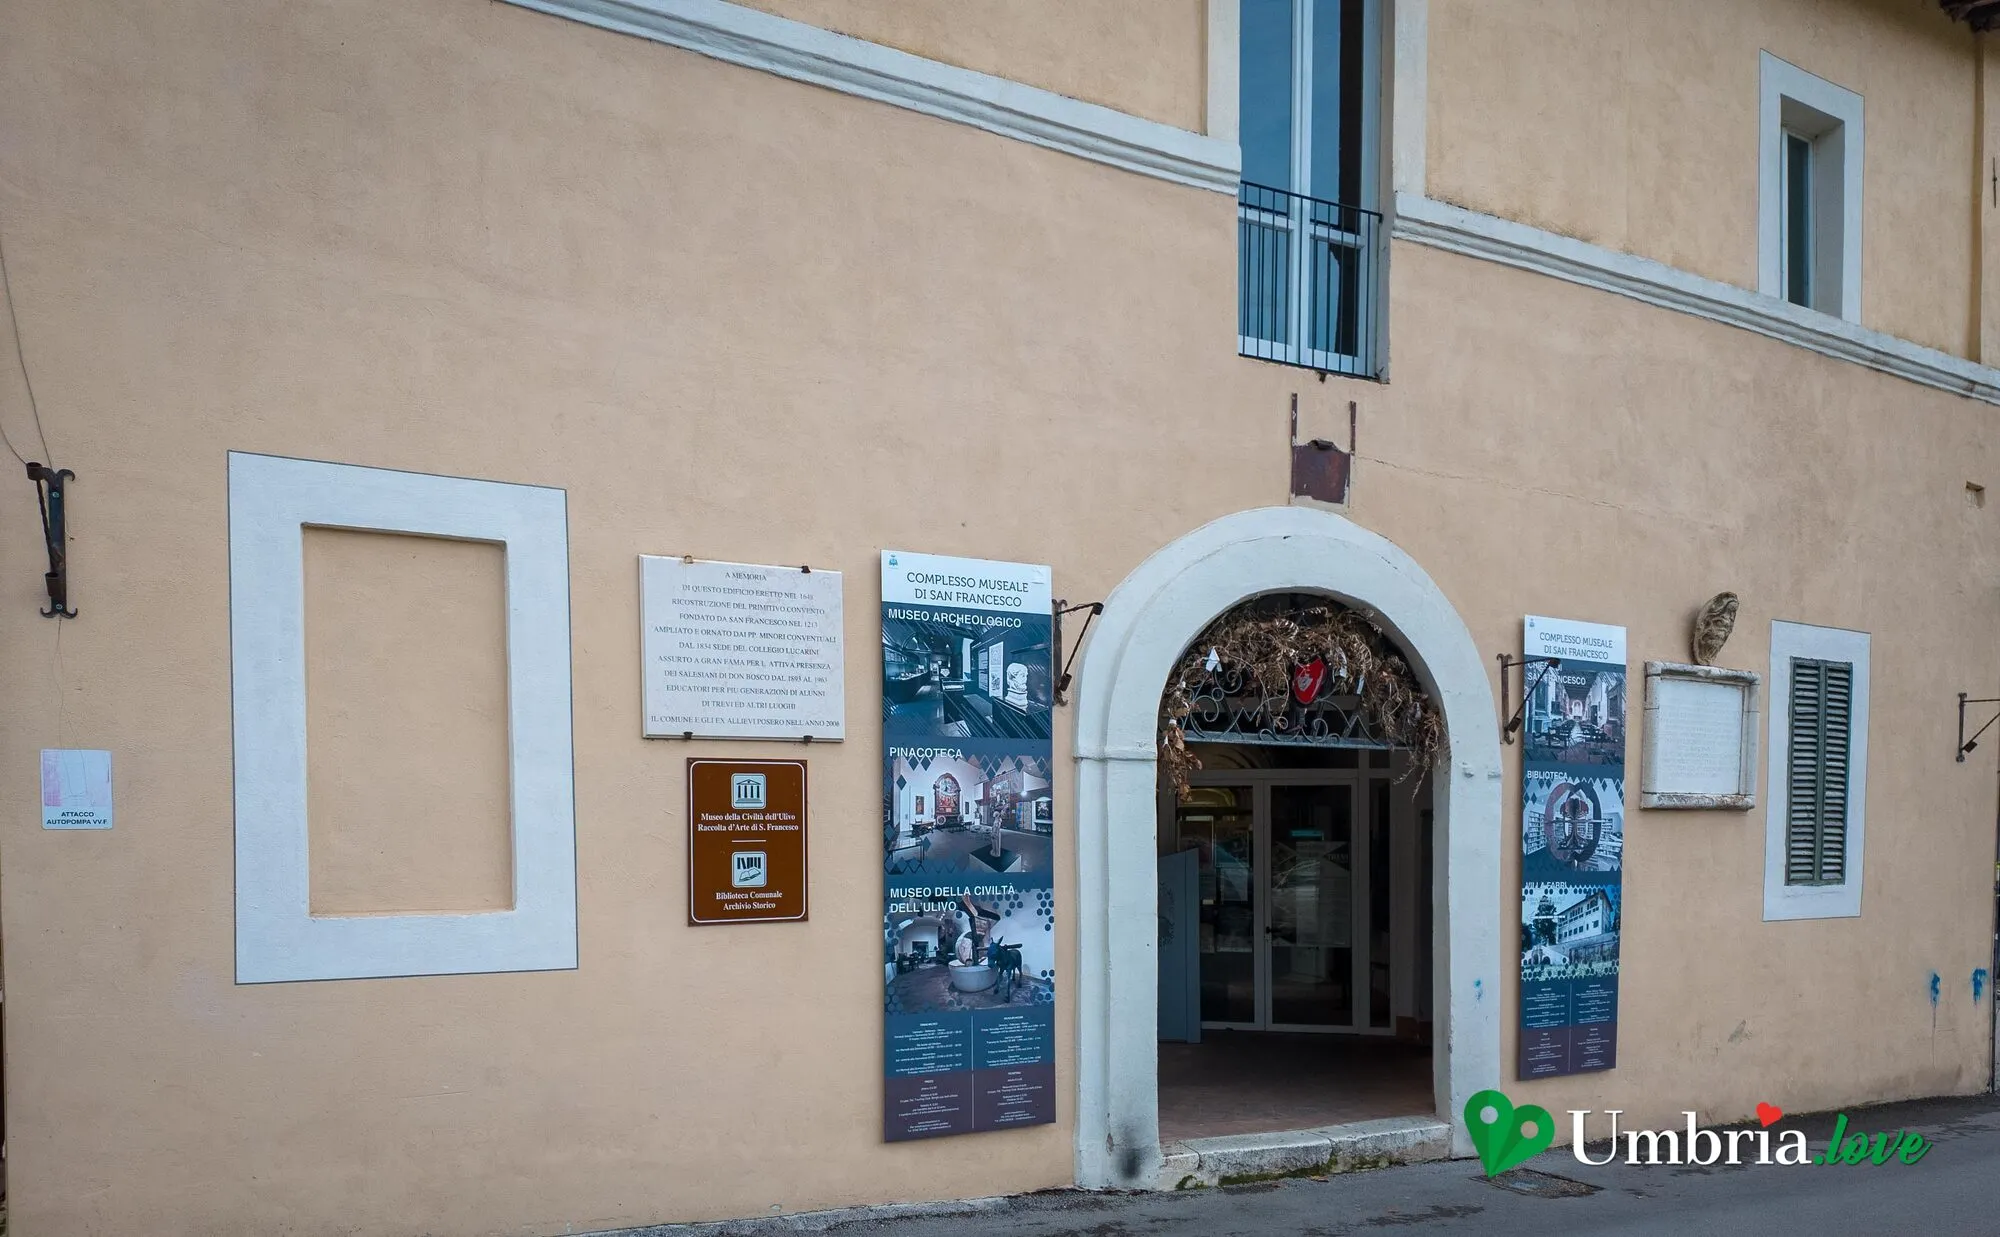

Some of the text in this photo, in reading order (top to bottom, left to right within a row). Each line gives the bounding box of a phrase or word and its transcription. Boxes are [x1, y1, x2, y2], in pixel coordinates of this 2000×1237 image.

[732, 572, 767, 581] MEMORIA
[907, 572, 1029, 593] COMPLESSO MUSEALE
[692, 585, 722, 594] QUESTO
[722, 587, 754, 596] EDIFICIO
[755, 590, 783, 598] ERETTO
[915, 588, 1022, 607] DI SAN FRANCESCO
[672, 598, 825, 615] RICOSTRUZIONE DEL PRIMITIVO CONVENTO
[679, 613, 716, 621] FONDATO
[729, 616, 744, 624] SAN
[745, 617, 788, 626] FRANCESCO
[888, 608, 1022, 628] MUSEO ARCHEOLOGICO
[654, 626, 693, 635] AMPLIATO
[700, 629, 732, 637] ORNATO
[760, 632, 786, 640] MINORI
[786, 633, 837, 643] CONVENTUALI
[1540, 632, 1613, 649] COMPLESSO MUSEALE
[712, 643, 732, 651] SEDE
[733, 644, 747, 652] DEL
[748, 645, 785, 654] COLLEGIO
[785, 647, 819, 656] LUCARINI
[1544, 645, 1609, 660] DI SAN FRANCESCO
[658, 655, 693, 663] ASSURTO
[701, 657, 722, 665] GRAN
[796, 662, 831, 670] PRESENZA
[1528, 661, 1551, 669] CHIES
[678, 670, 718, 679] SALESIANI
[746, 673, 770, 681] BOSCO
[666, 685, 710, 693] EDUCATORI
[711, 686, 725, 694] PER
[740, 688, 788, 696] GENERAZIONI
[727, 717, 756, 725] ALLIEVI
[889, 747, 963, 759] PINACOTECA
[1527, 770, 1568, 780] BIBLIOTECA
[701, 812, 796, 821] Museo della Civiltà dell'Ulivo
[697, 824, 727, 832] Raccolta
[751, 823, 758, 831] di
[716, 891, 783, 900] Biblioteca Comunale
[890, 882, 1016, 899] MUSEO DELLA CIVILTÀ
[723, 901, 776, 911] Archivio Storico
[890, 901, 957, 913] DELL'ULIVO
